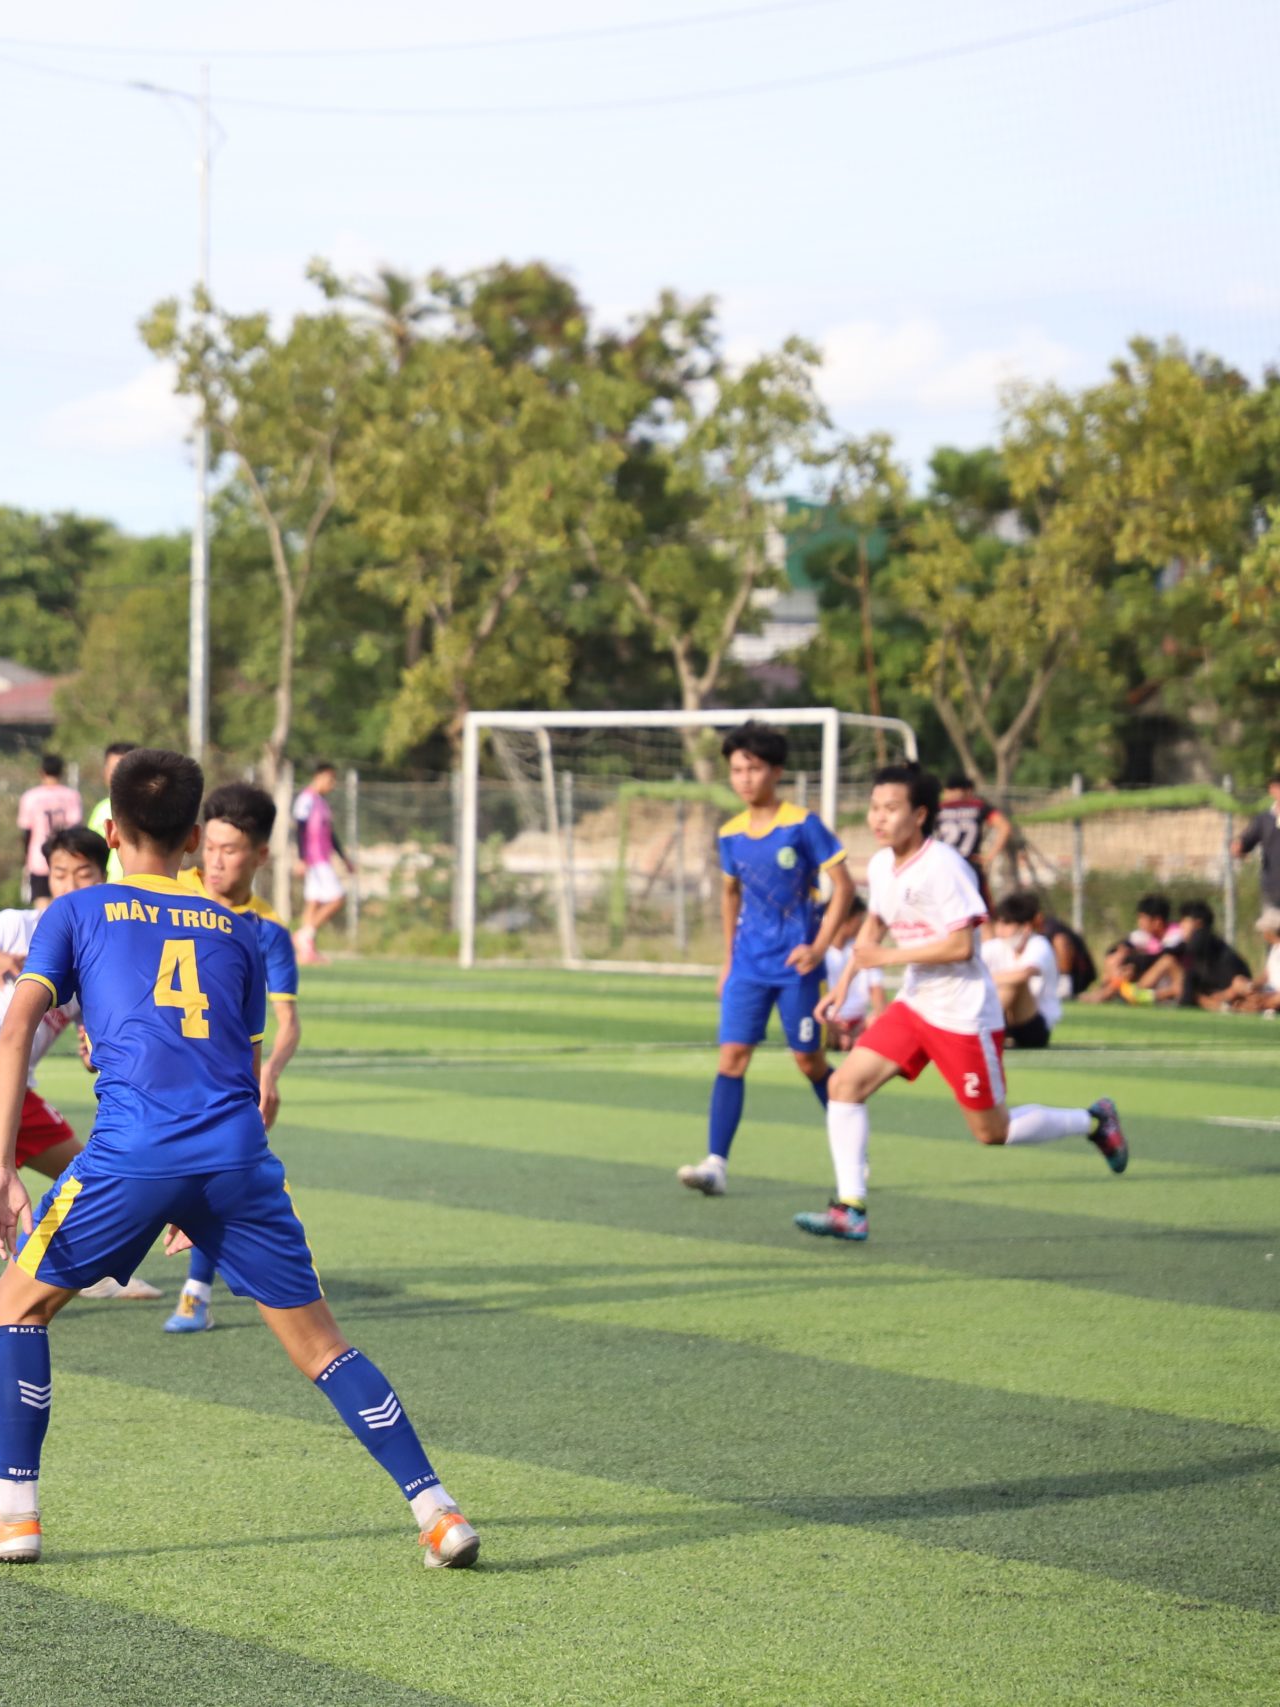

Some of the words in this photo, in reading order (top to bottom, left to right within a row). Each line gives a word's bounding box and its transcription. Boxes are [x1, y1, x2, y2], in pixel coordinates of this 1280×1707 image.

[104, 899, 160, 924] MÂY
[167, 908, 233, 934] TRÚC
[153, 939, 210, 1039] 4
[798, 1016, 815, 1043] 8
[963, 1072, 980, 1098] 2
